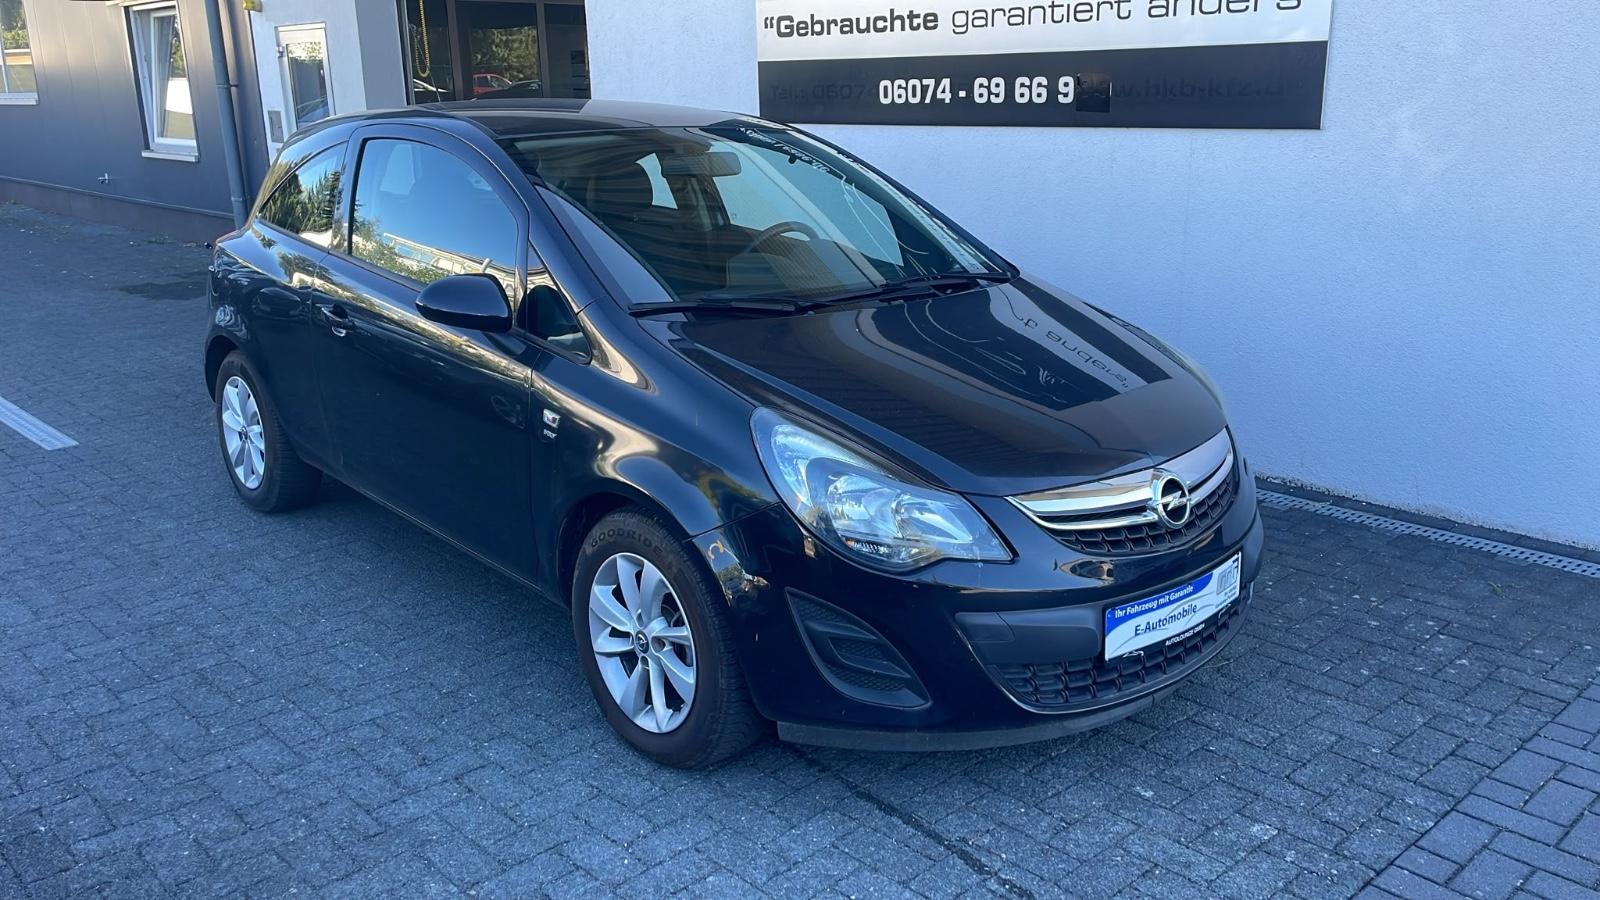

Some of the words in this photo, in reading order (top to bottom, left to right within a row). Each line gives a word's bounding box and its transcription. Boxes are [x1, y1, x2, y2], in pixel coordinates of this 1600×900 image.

[952, 0, 1132, 35] garantiert
[879, 78, 952, 104] 06074
[973, 77, 1006, 104] 69
[1014, 76, 1048, 104] 66
[591, 527, 664, 555] GOODRIDE
[1115, 607, 1126, 619] Ihr
[1126, 599, 1158, 616] Fahrzeug
[1159, 593, 1169, 606] mit
[1170, 585, 1194, 602] Garantie
[1134, 602, 1198, 637] E-Automobile
